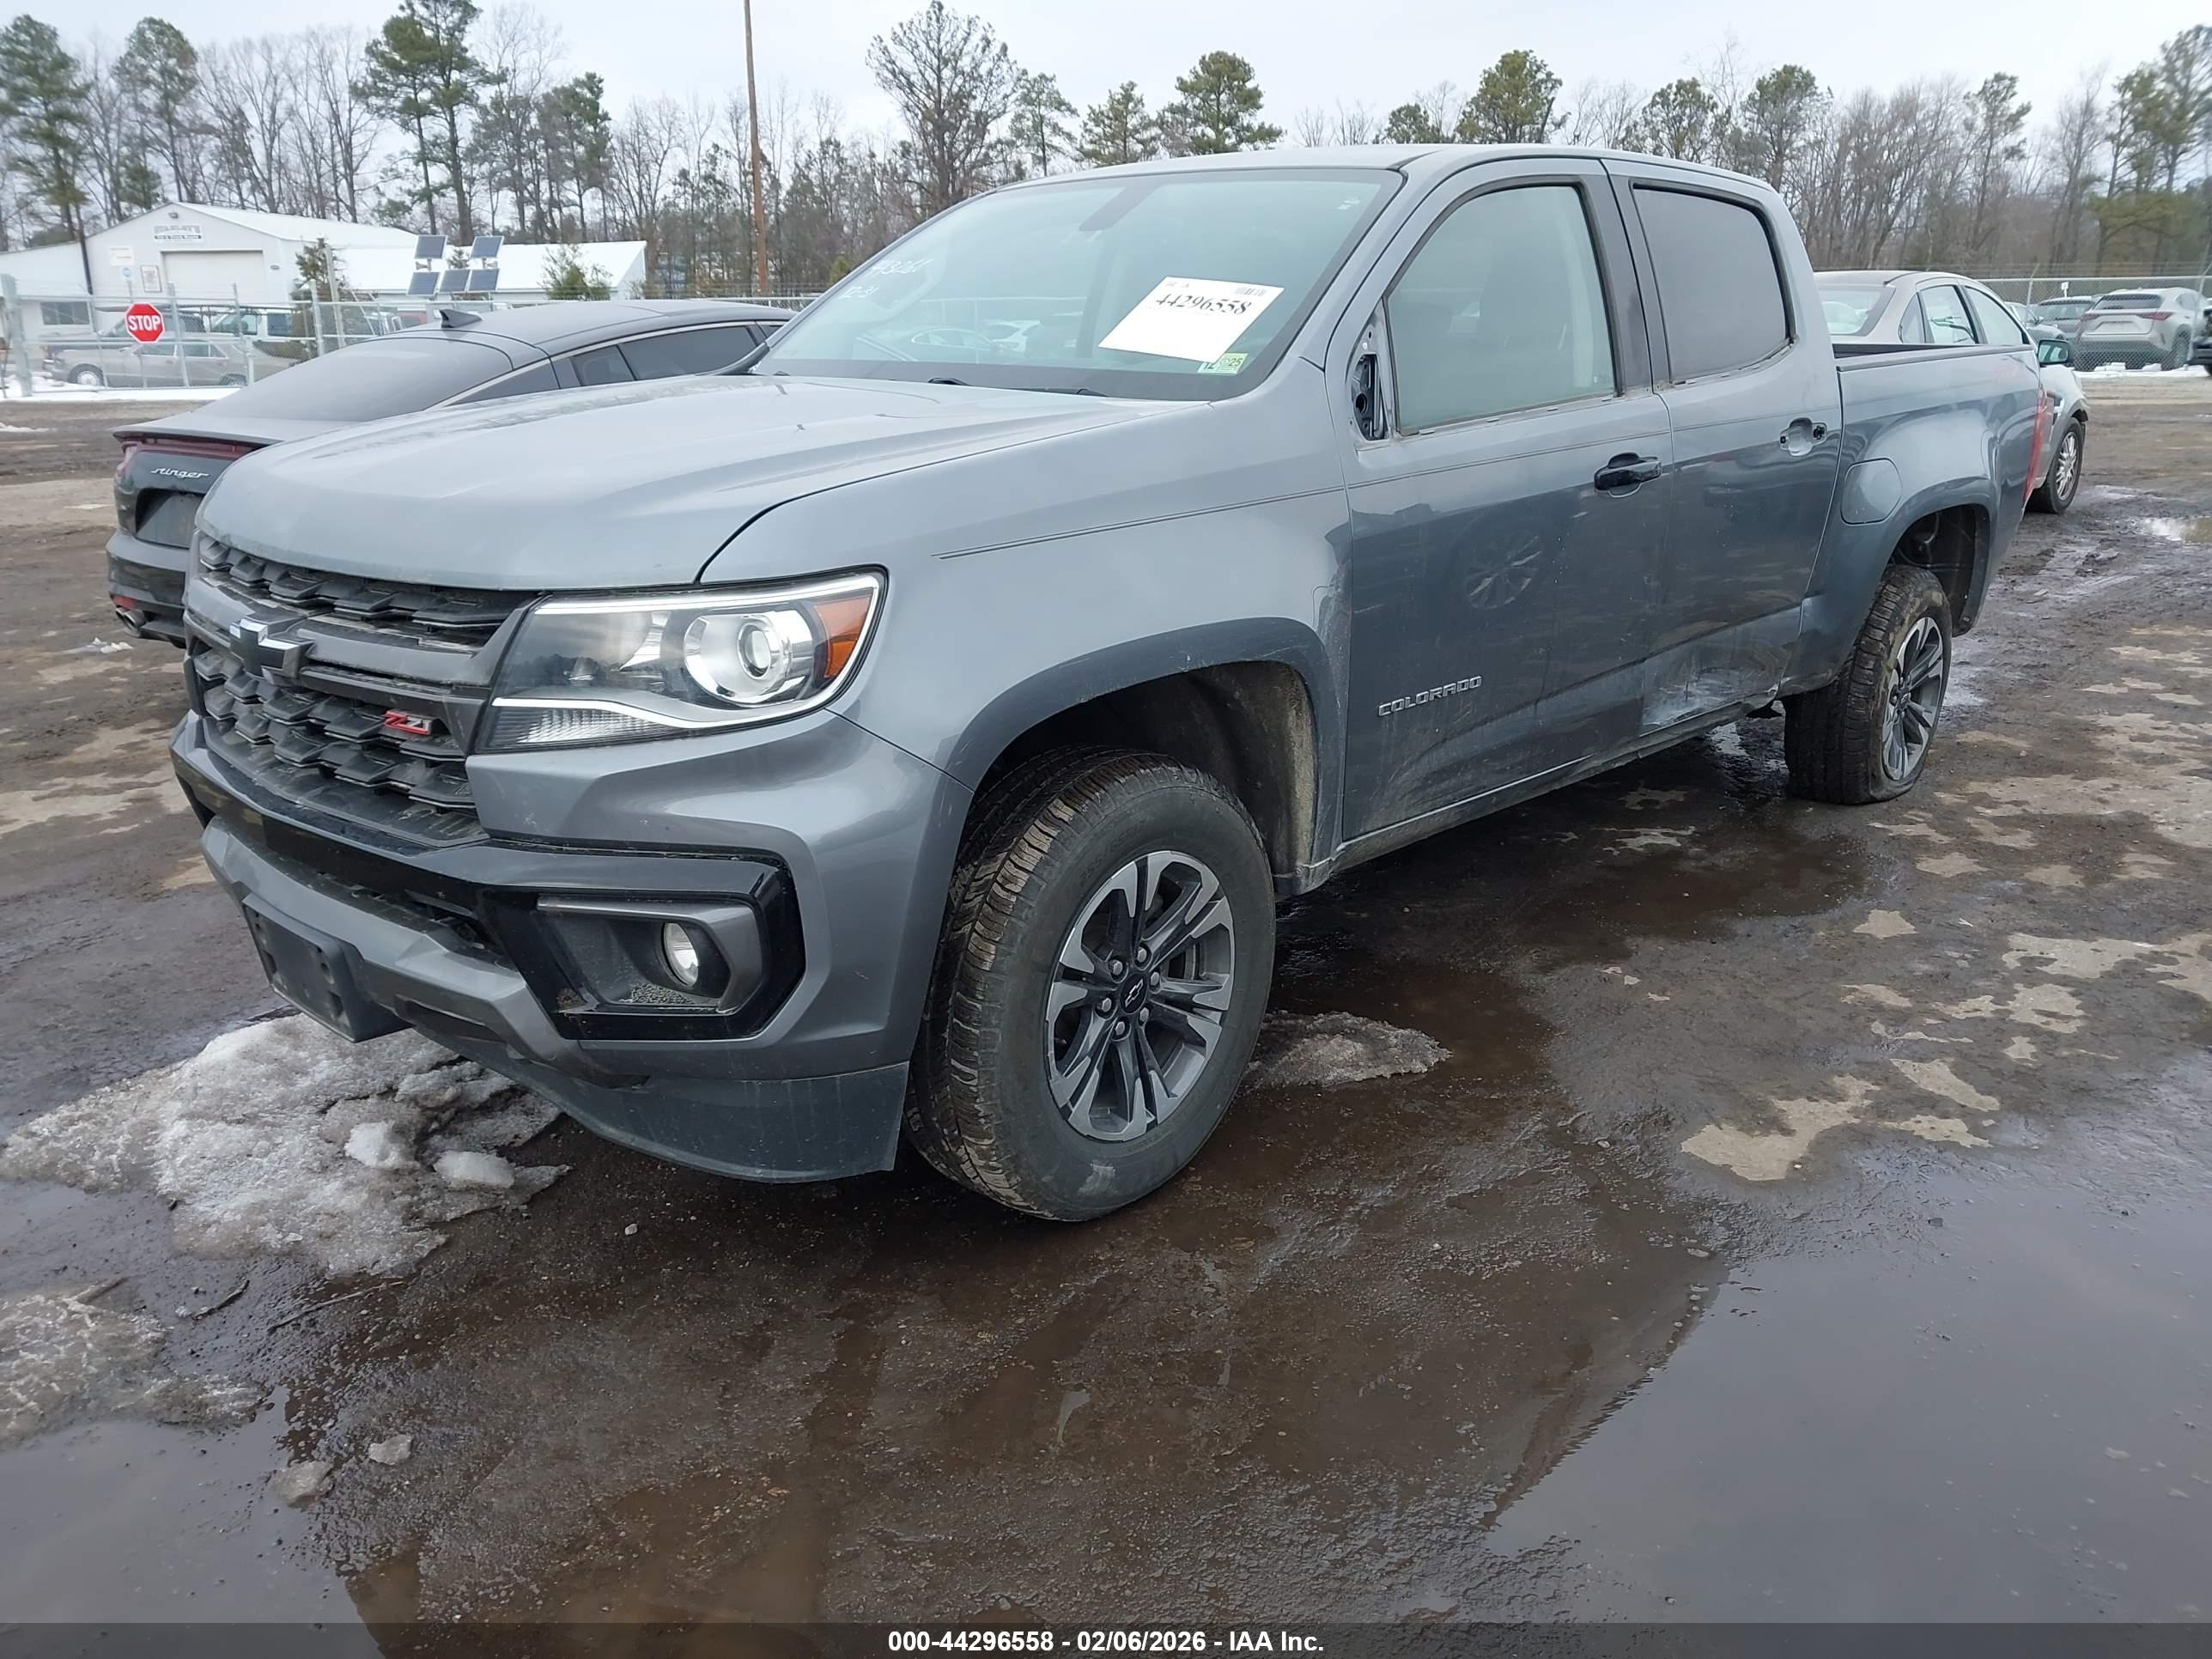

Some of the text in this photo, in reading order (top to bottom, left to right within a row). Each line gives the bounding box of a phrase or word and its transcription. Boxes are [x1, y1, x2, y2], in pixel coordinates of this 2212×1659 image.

[1156, 294, 1252, 315] 44296558
[128, 315, 161, 331] STOP
[1229, 357, 1243, 367] 25
[1378, 676, 1482, 716] COLORADO
[384, 710, 431, 735] Z71
